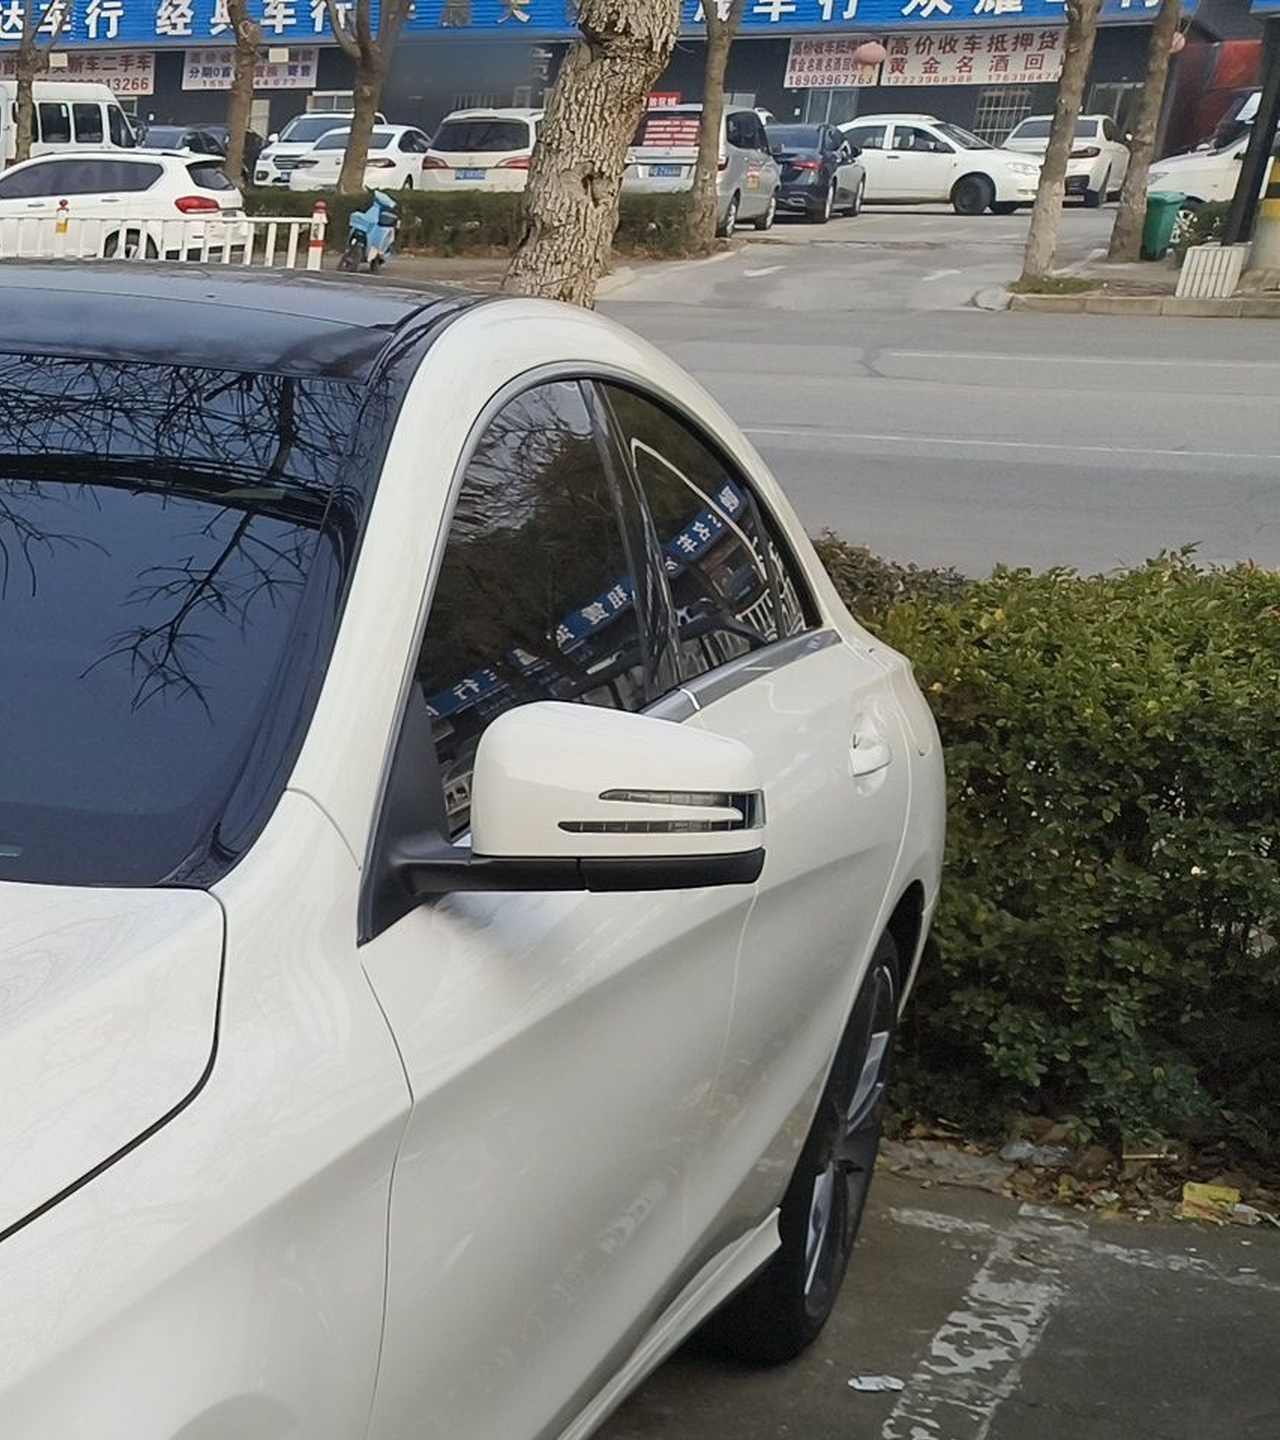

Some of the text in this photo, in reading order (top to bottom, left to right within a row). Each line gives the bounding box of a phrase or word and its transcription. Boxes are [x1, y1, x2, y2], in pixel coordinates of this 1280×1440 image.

[888, 53, 1066, 75] 黄金名酒回
